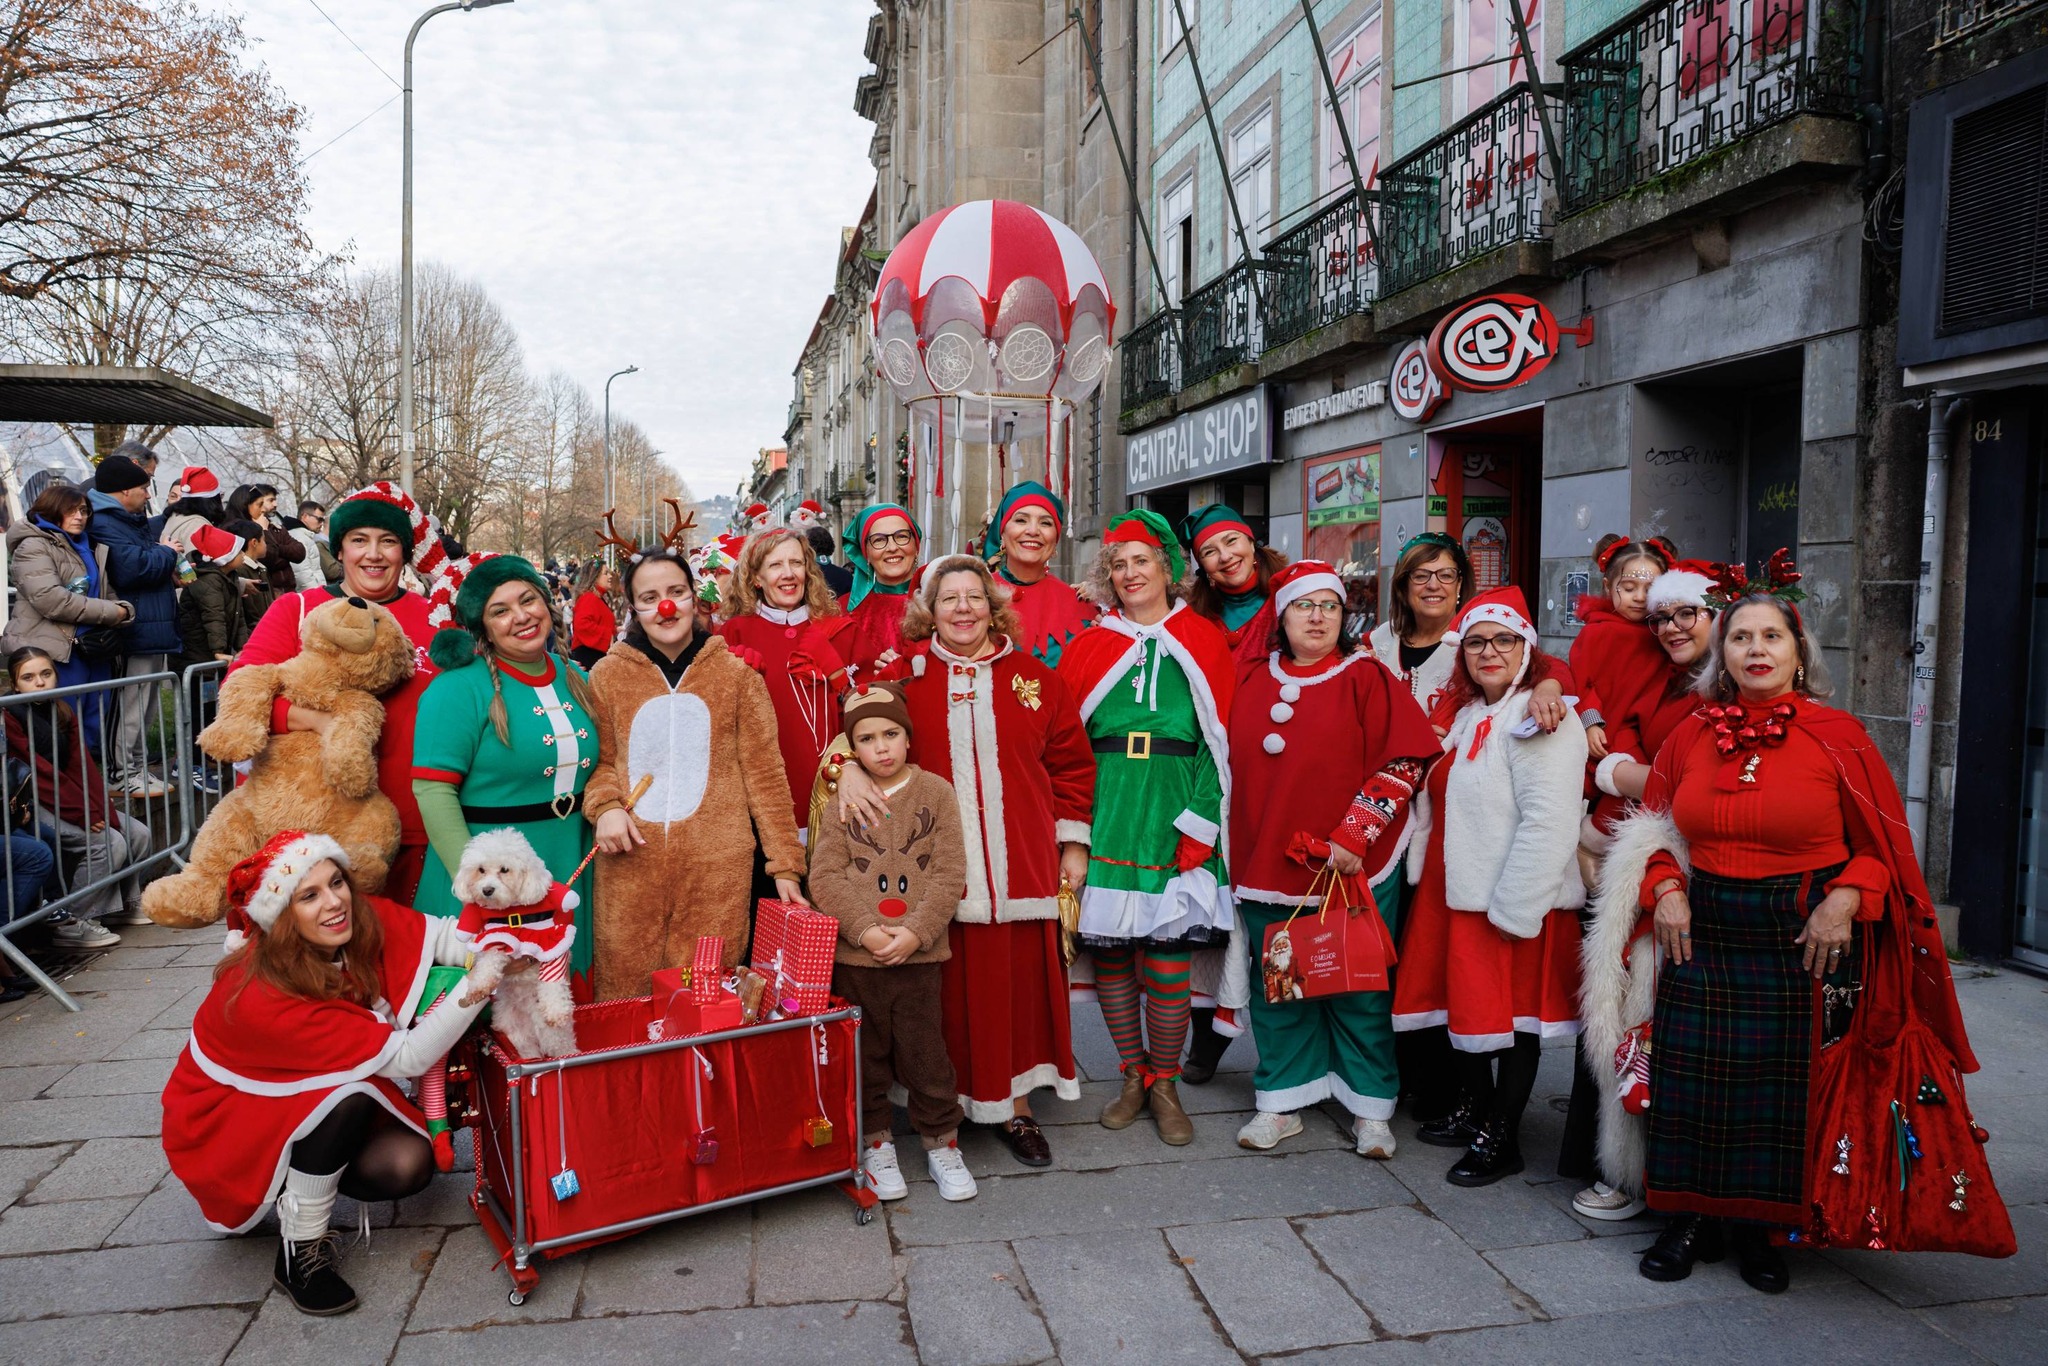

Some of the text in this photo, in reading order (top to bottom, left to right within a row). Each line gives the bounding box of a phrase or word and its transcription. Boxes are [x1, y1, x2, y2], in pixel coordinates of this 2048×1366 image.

[1283, 380, 1386, 430] ENTERTAINMENT
[1975, 418, 2003, 442] 84
[1129, 397, 1259, 485] CENTRAL SHOP
